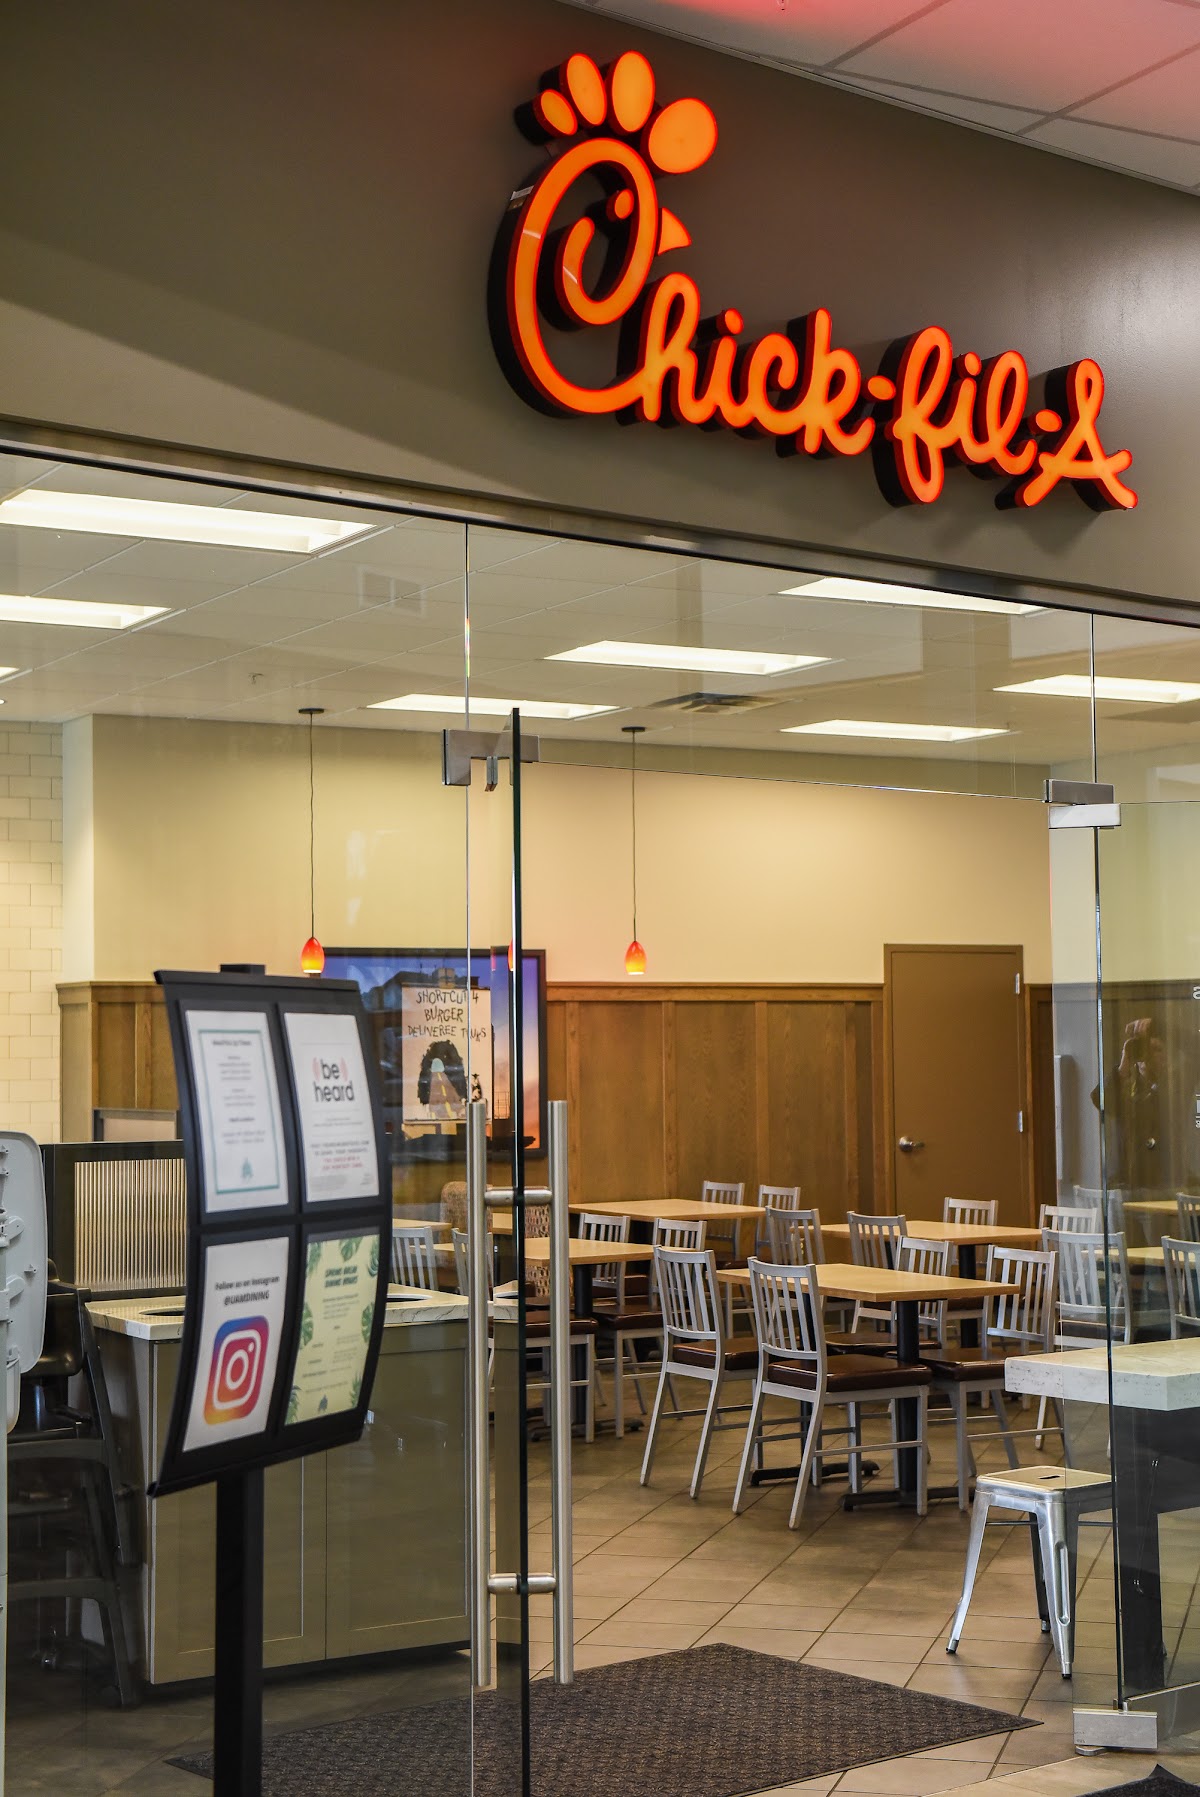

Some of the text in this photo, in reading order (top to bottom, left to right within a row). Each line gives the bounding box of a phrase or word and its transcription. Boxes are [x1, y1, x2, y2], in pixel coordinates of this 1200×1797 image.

[507, 138, 1139, 510] Chick-fil-A
[416, 988, 480, 1005] SHORTCUT 4
[424, 1006, 464, 1023] BURGER
[320, 1058, 340, 1080] be
[313, 1080, 355, 1102] heard
[215, 1281, 234, 1290] Follow
[251, 1276, 280, 1286] Instagram
